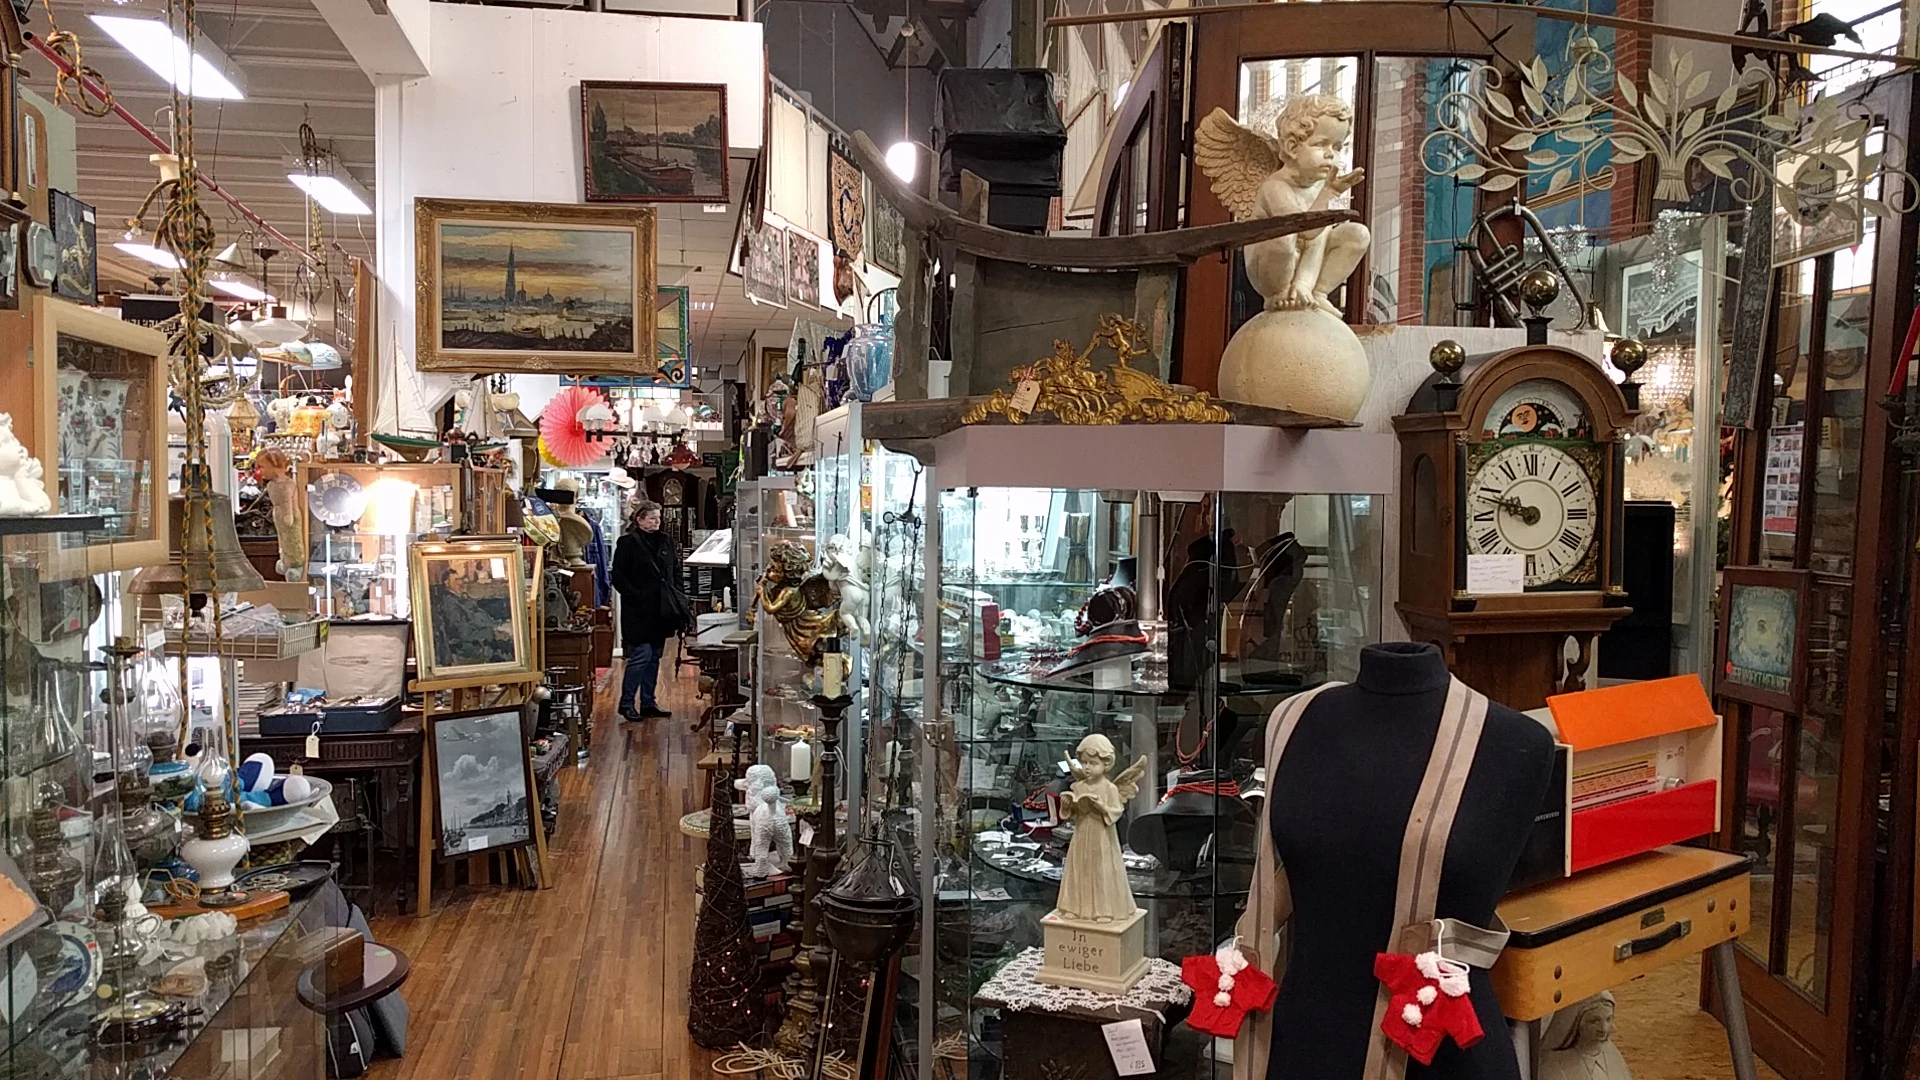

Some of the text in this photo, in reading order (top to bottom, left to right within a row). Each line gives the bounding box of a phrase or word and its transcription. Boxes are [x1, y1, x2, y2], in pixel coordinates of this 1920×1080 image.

[1523, 454, 1538, 477] XII
[1560, 480, 1582, 498] II
[1567, 508, 1588, 520] III
[1558, 528, 1582, 551] IIII
[1072, 930, 1087, 943] In
[1058, 942, 1104, 959] ewiger
[1063, 957, 1100, 973] Liebe
